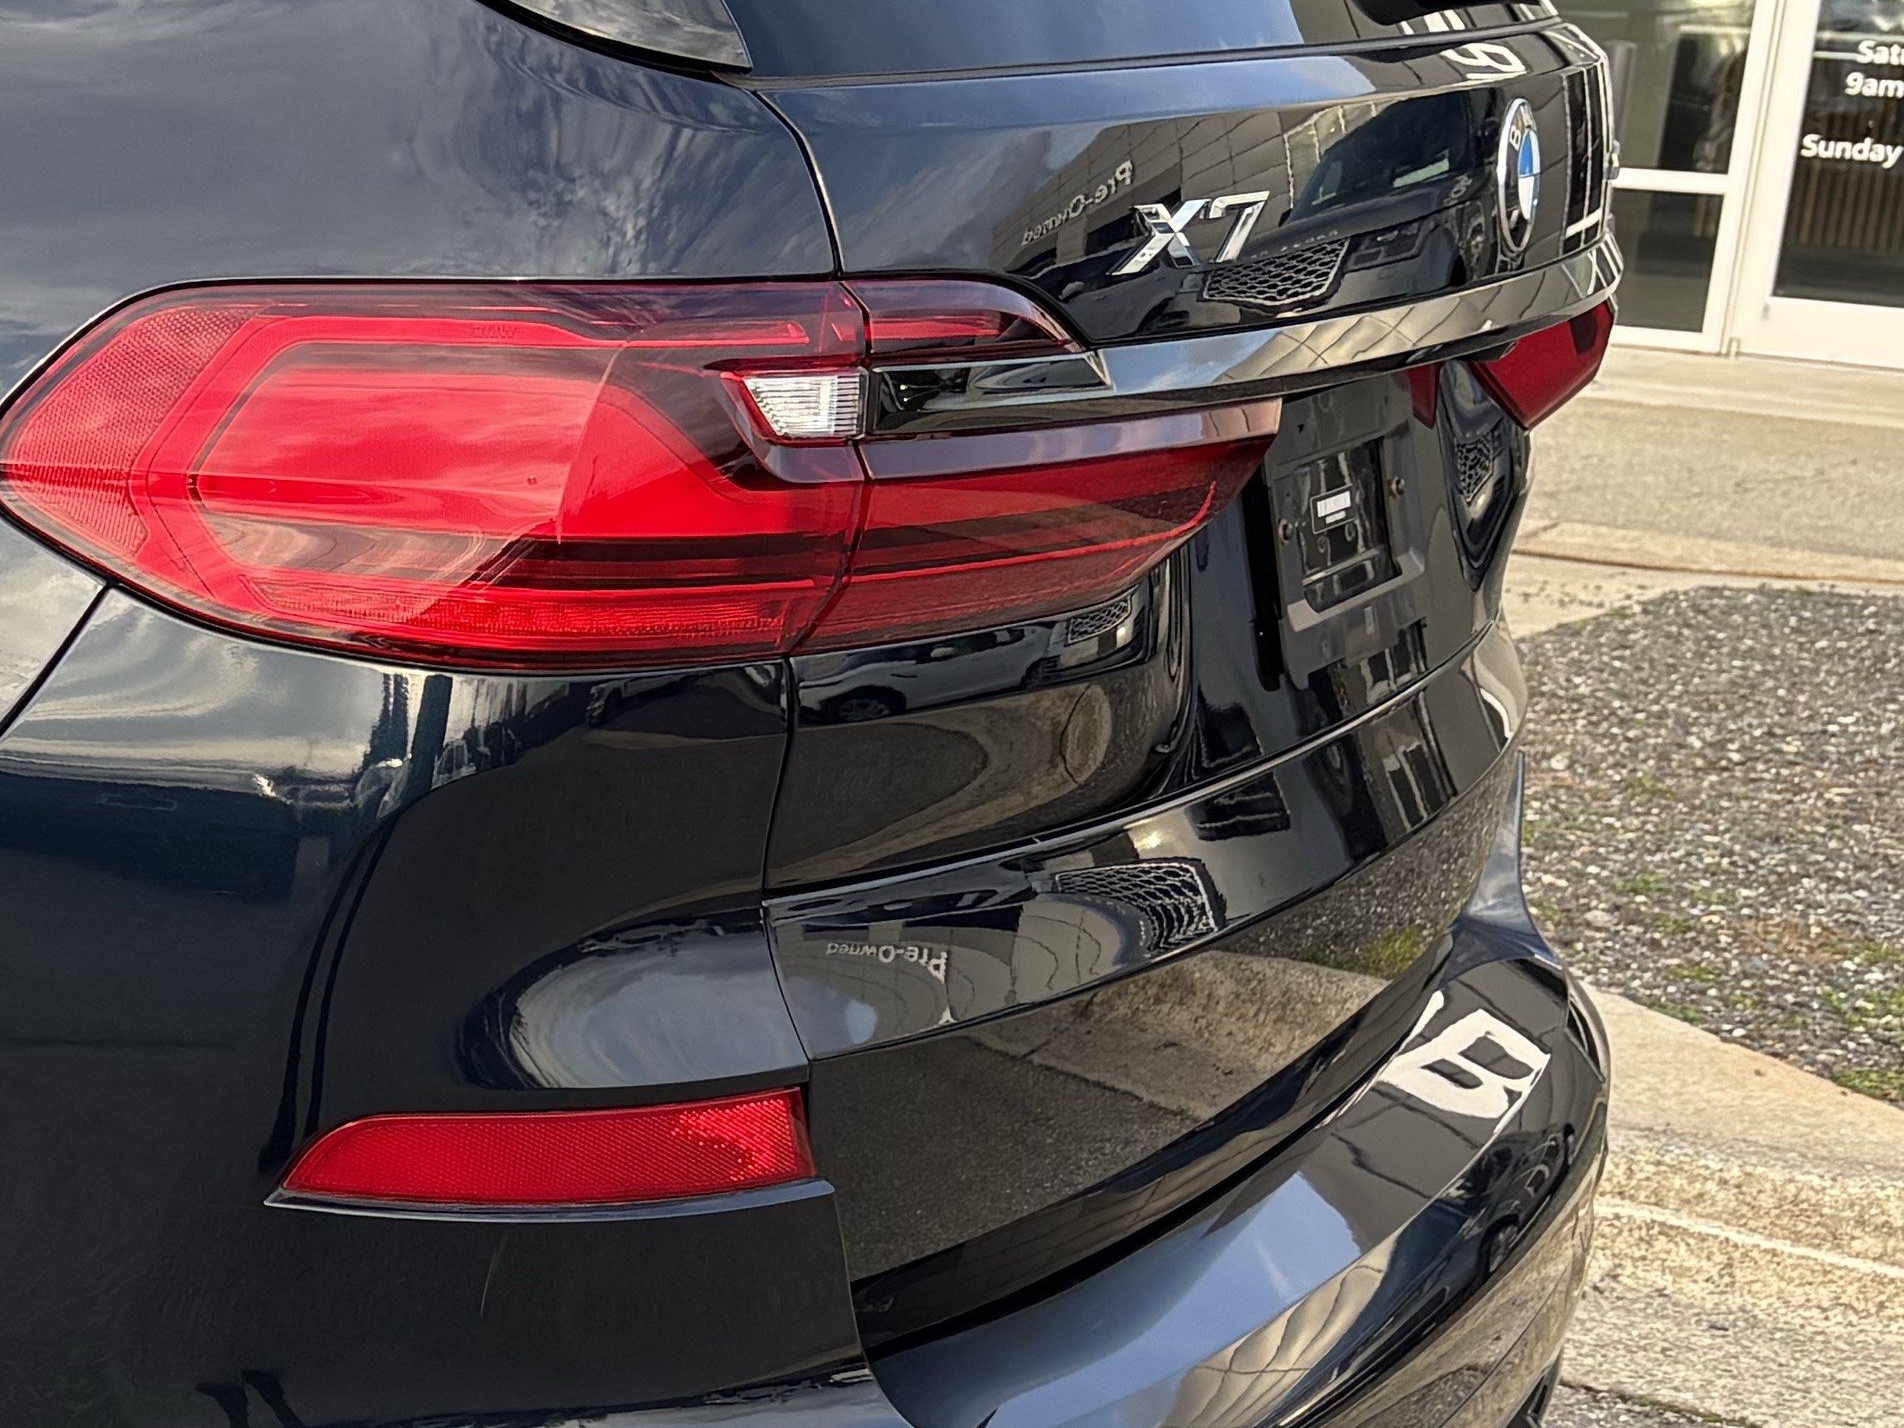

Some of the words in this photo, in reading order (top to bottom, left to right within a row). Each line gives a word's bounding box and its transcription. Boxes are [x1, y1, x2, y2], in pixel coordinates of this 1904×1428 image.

[1855, 39, 1904, 65] Sat
[1844, 71, 1904, 98] 9am
[1800, 133, 1904, 169] Sunday
[1105, 190, 1270, 276] X7
